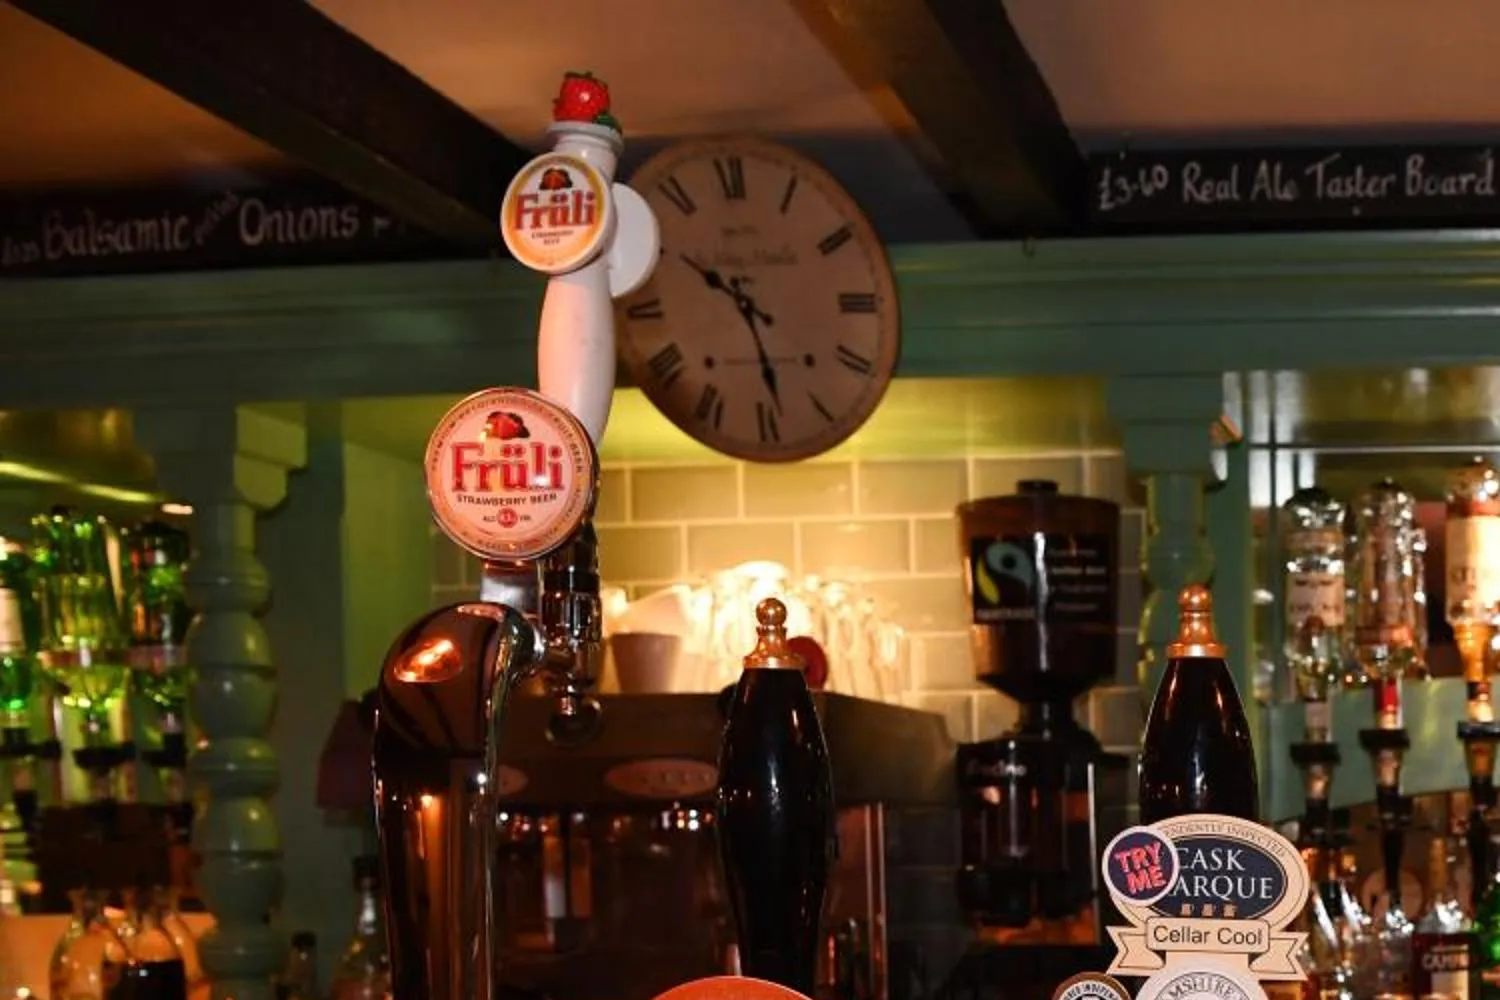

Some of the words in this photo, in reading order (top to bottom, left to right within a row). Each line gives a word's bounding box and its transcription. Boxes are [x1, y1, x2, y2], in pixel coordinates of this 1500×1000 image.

[1181, 160, 1241, 203] Real
[1250, 158, 1300, 201] Ale
[1304, 152, 1397, 199] Taster
[1405, 152, 1496, 197] Board
[514, 190, 596, 230] Früli
[42, 208, 192, 261] Balsamic
[238, 197, 362, 247] Onions
[450, 441, 565, 492] Früli
[456, 494, 527, 506] STRAWBERRY
[530, 493, 557, 504] BEER
[1113, 841, 1162, 872] TRY
[1124, 865, 1168, 894] ME
[1168, 876, 1273, 900] ARQUE
[1153, 925, 1210, 944] Cellar
[1217, 927, 1262, 944] Cool
